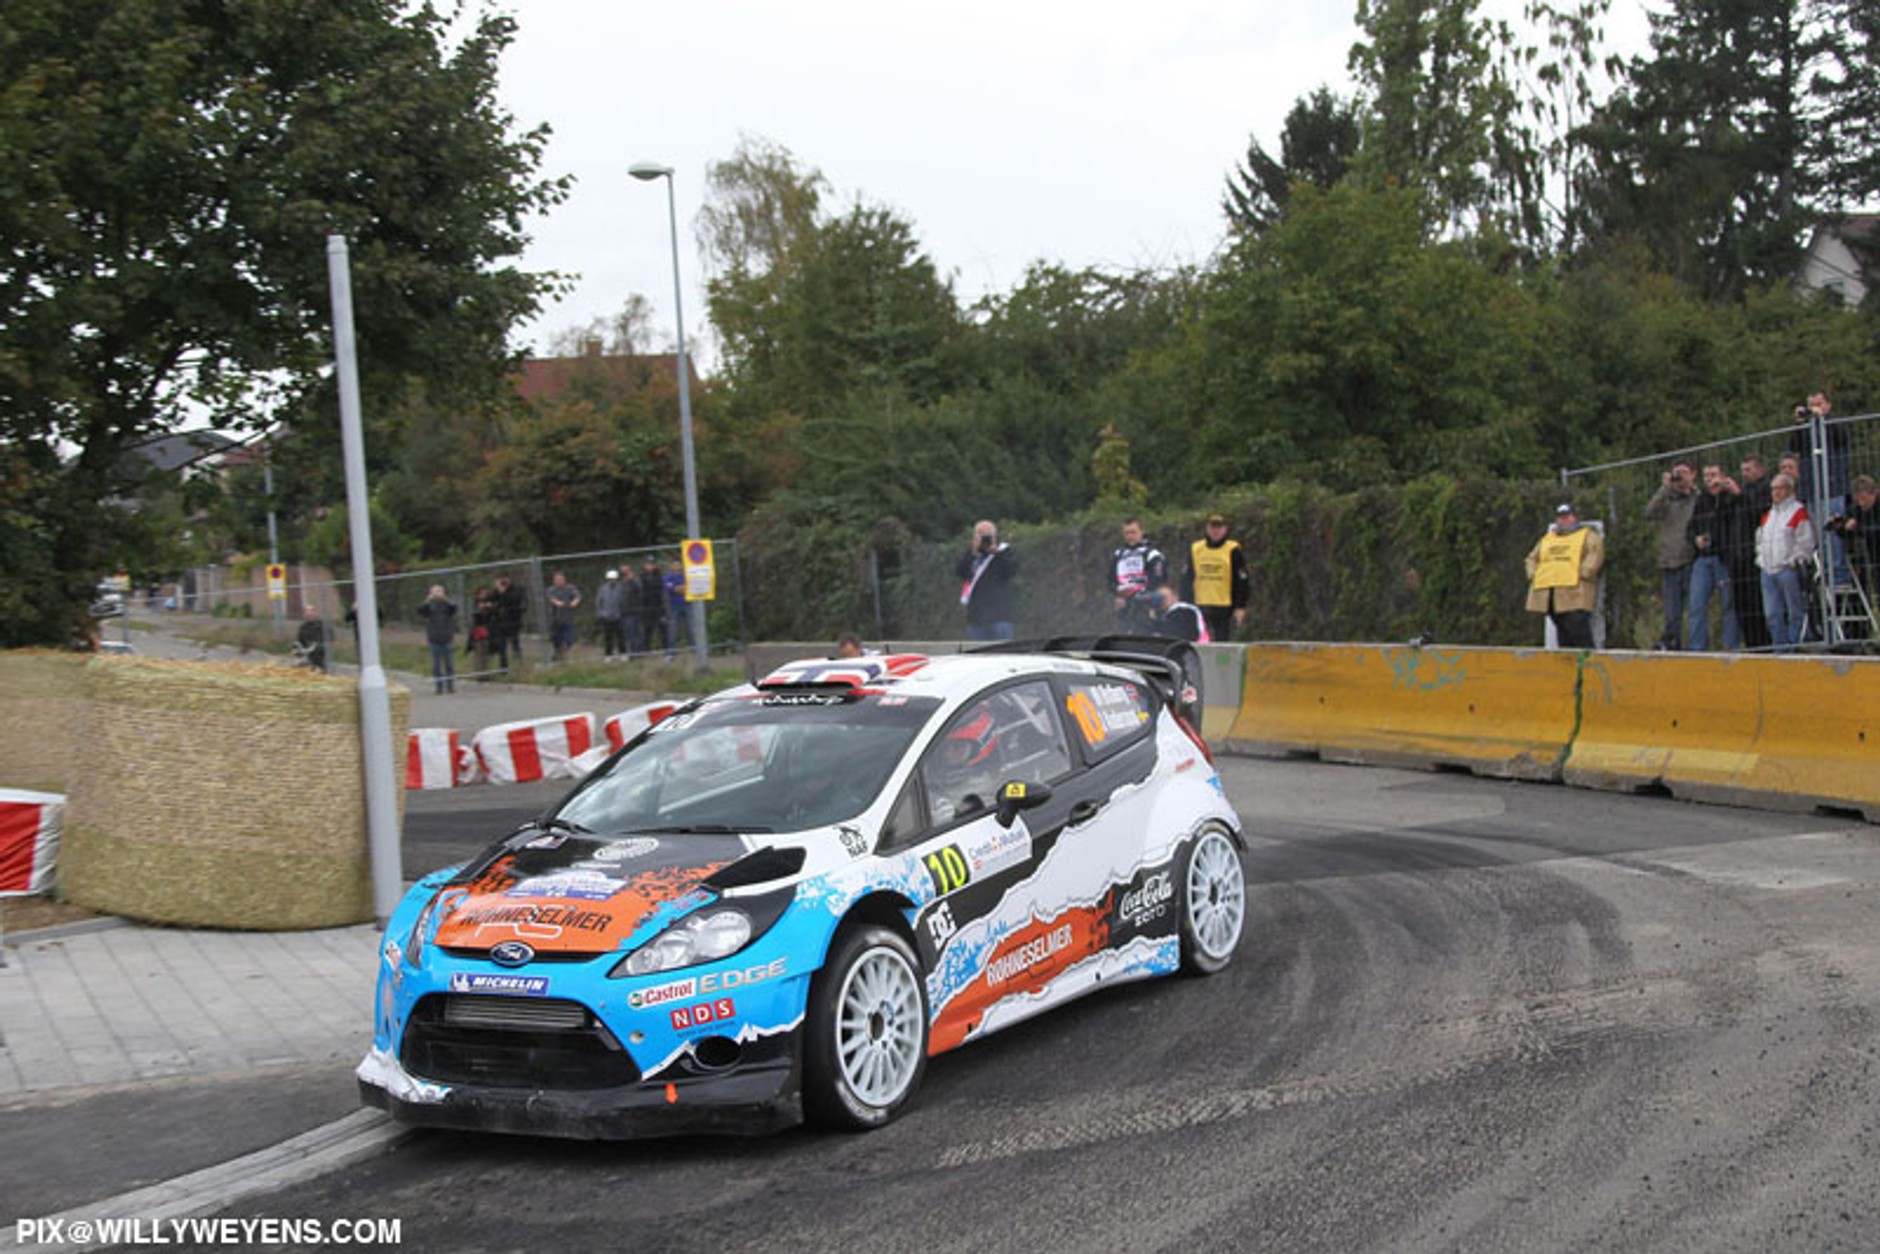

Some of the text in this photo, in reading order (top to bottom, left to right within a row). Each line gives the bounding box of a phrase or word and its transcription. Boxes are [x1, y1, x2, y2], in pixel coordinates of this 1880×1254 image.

[1066, 692, 1106, 745] 10
[929, 846, 967, 895] 10
[472, 976, 545, 991] MICHELIN
[644, 955, 788, 1005] Castrol EDGE
